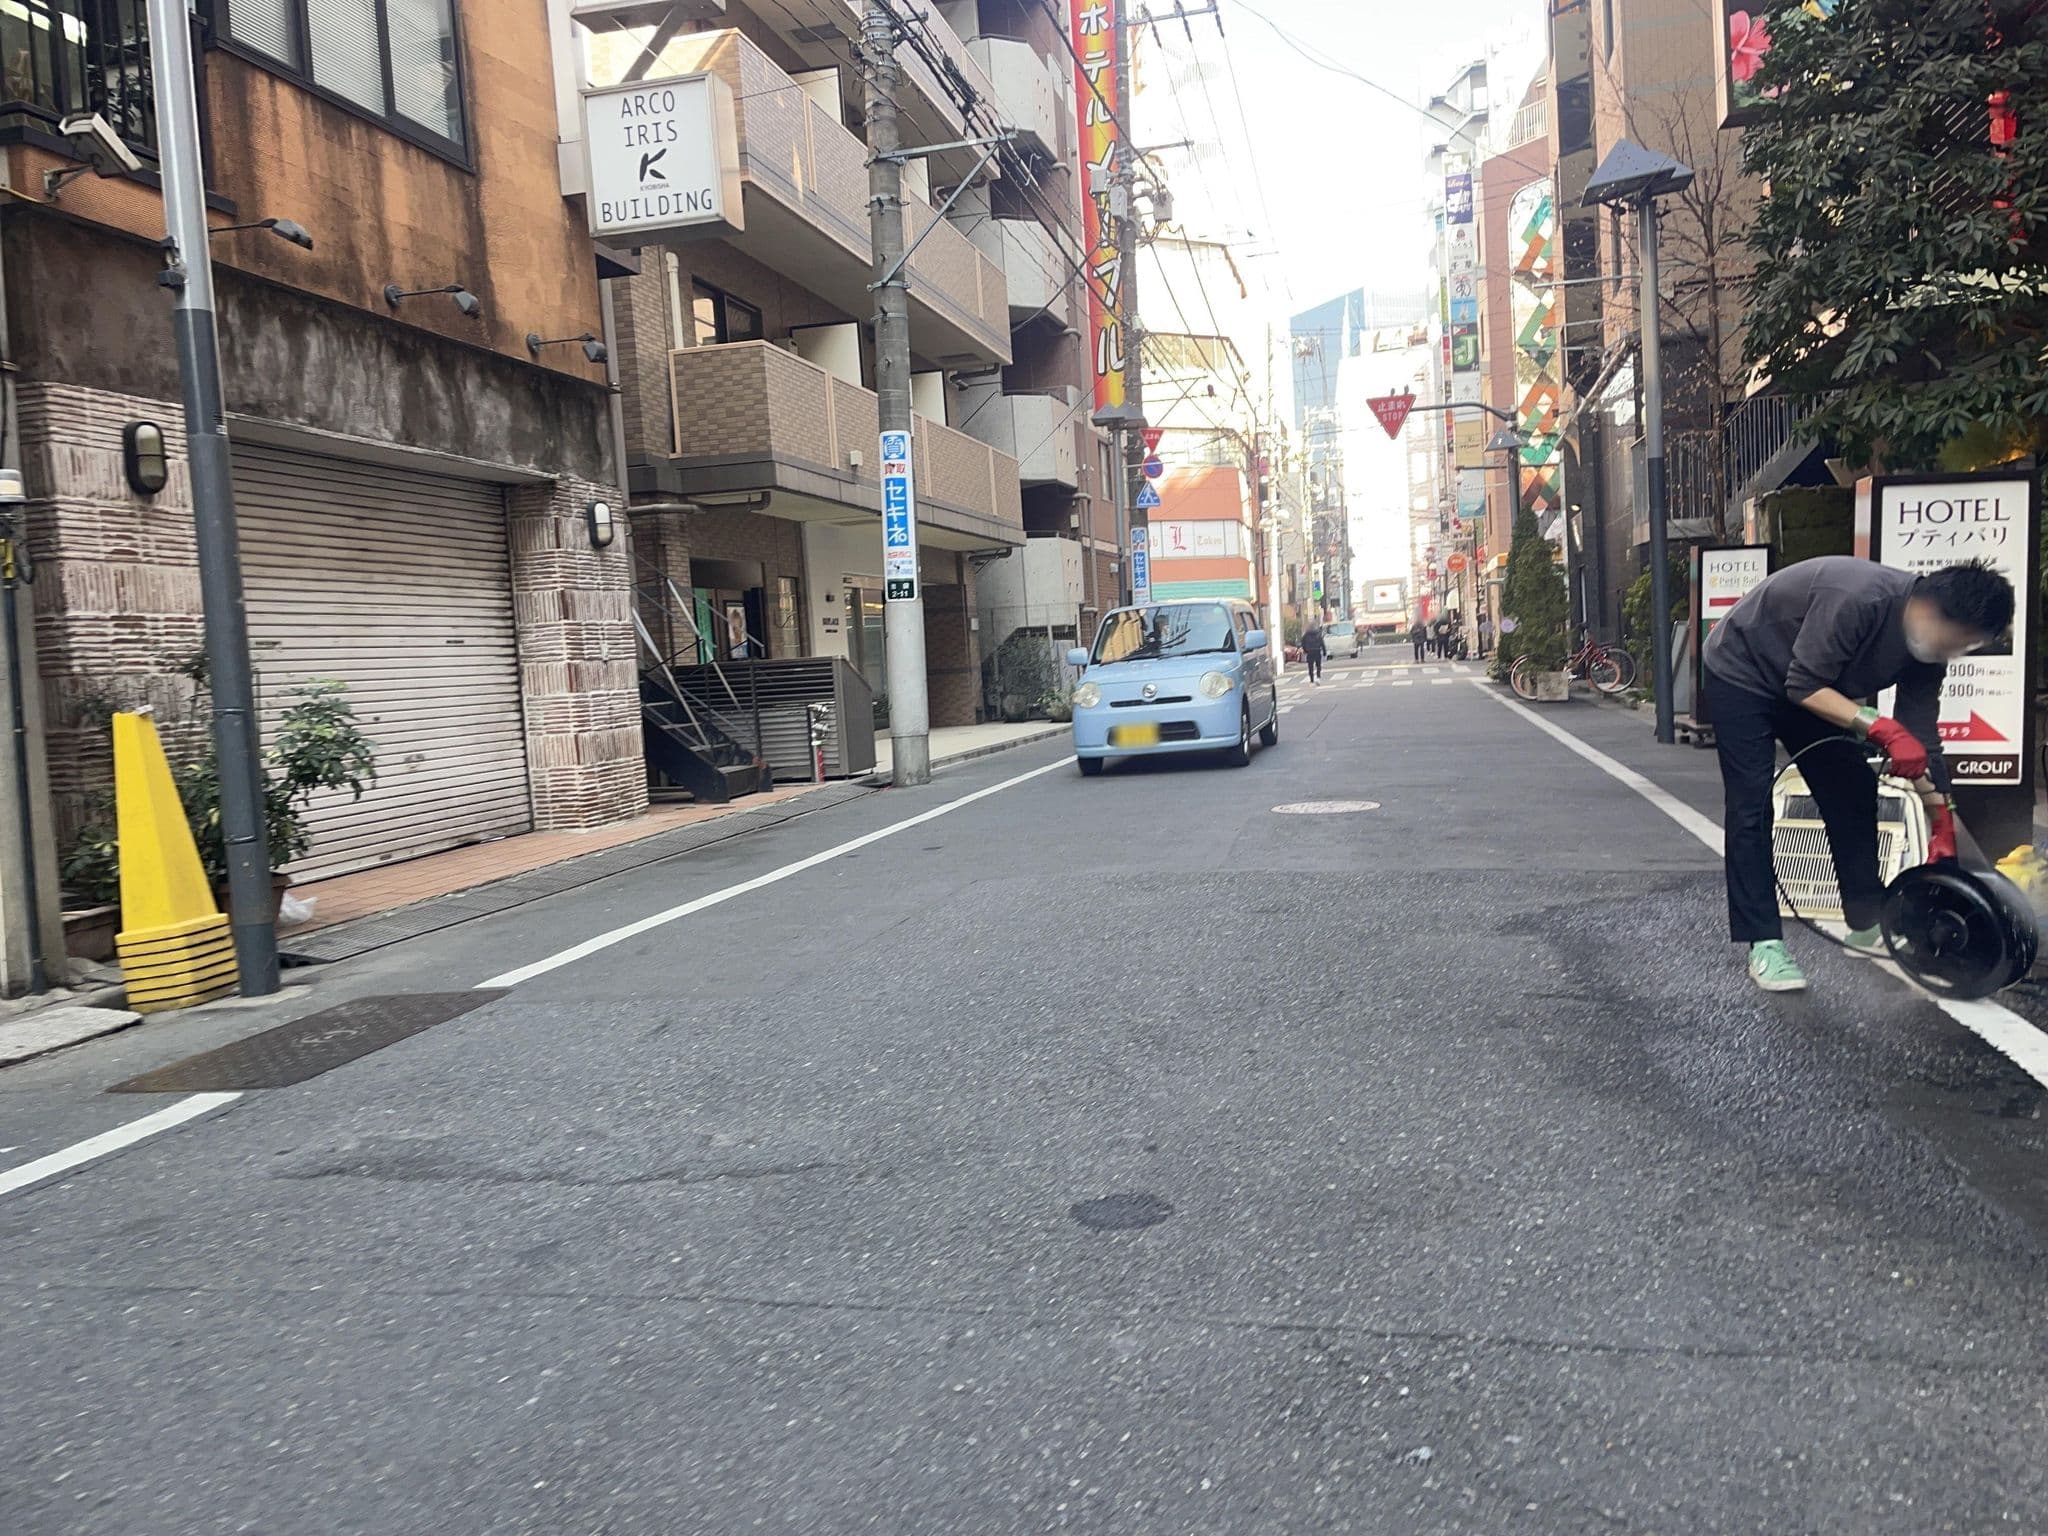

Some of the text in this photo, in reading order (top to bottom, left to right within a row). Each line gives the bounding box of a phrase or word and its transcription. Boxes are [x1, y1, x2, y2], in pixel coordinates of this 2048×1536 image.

[621, 90, 675, 118] ARCO
[624, 120, 678, 147] IRIS
[639, 148, 667, 182] K
[602, 188, 713, 223] BUILDING
[1378, 400, 1406, 412] 止まれ
[1382, 411, 1404, 422] STOP
[886, 480, 908, 544] セキネ
[1899, 498, 2011, 525] HOTEL
[1897, 526, 2008, 549] プティバリ
[1710, 561, 1759, 573] HOTEL
[1956, 760, 2013, 774] GROUP
